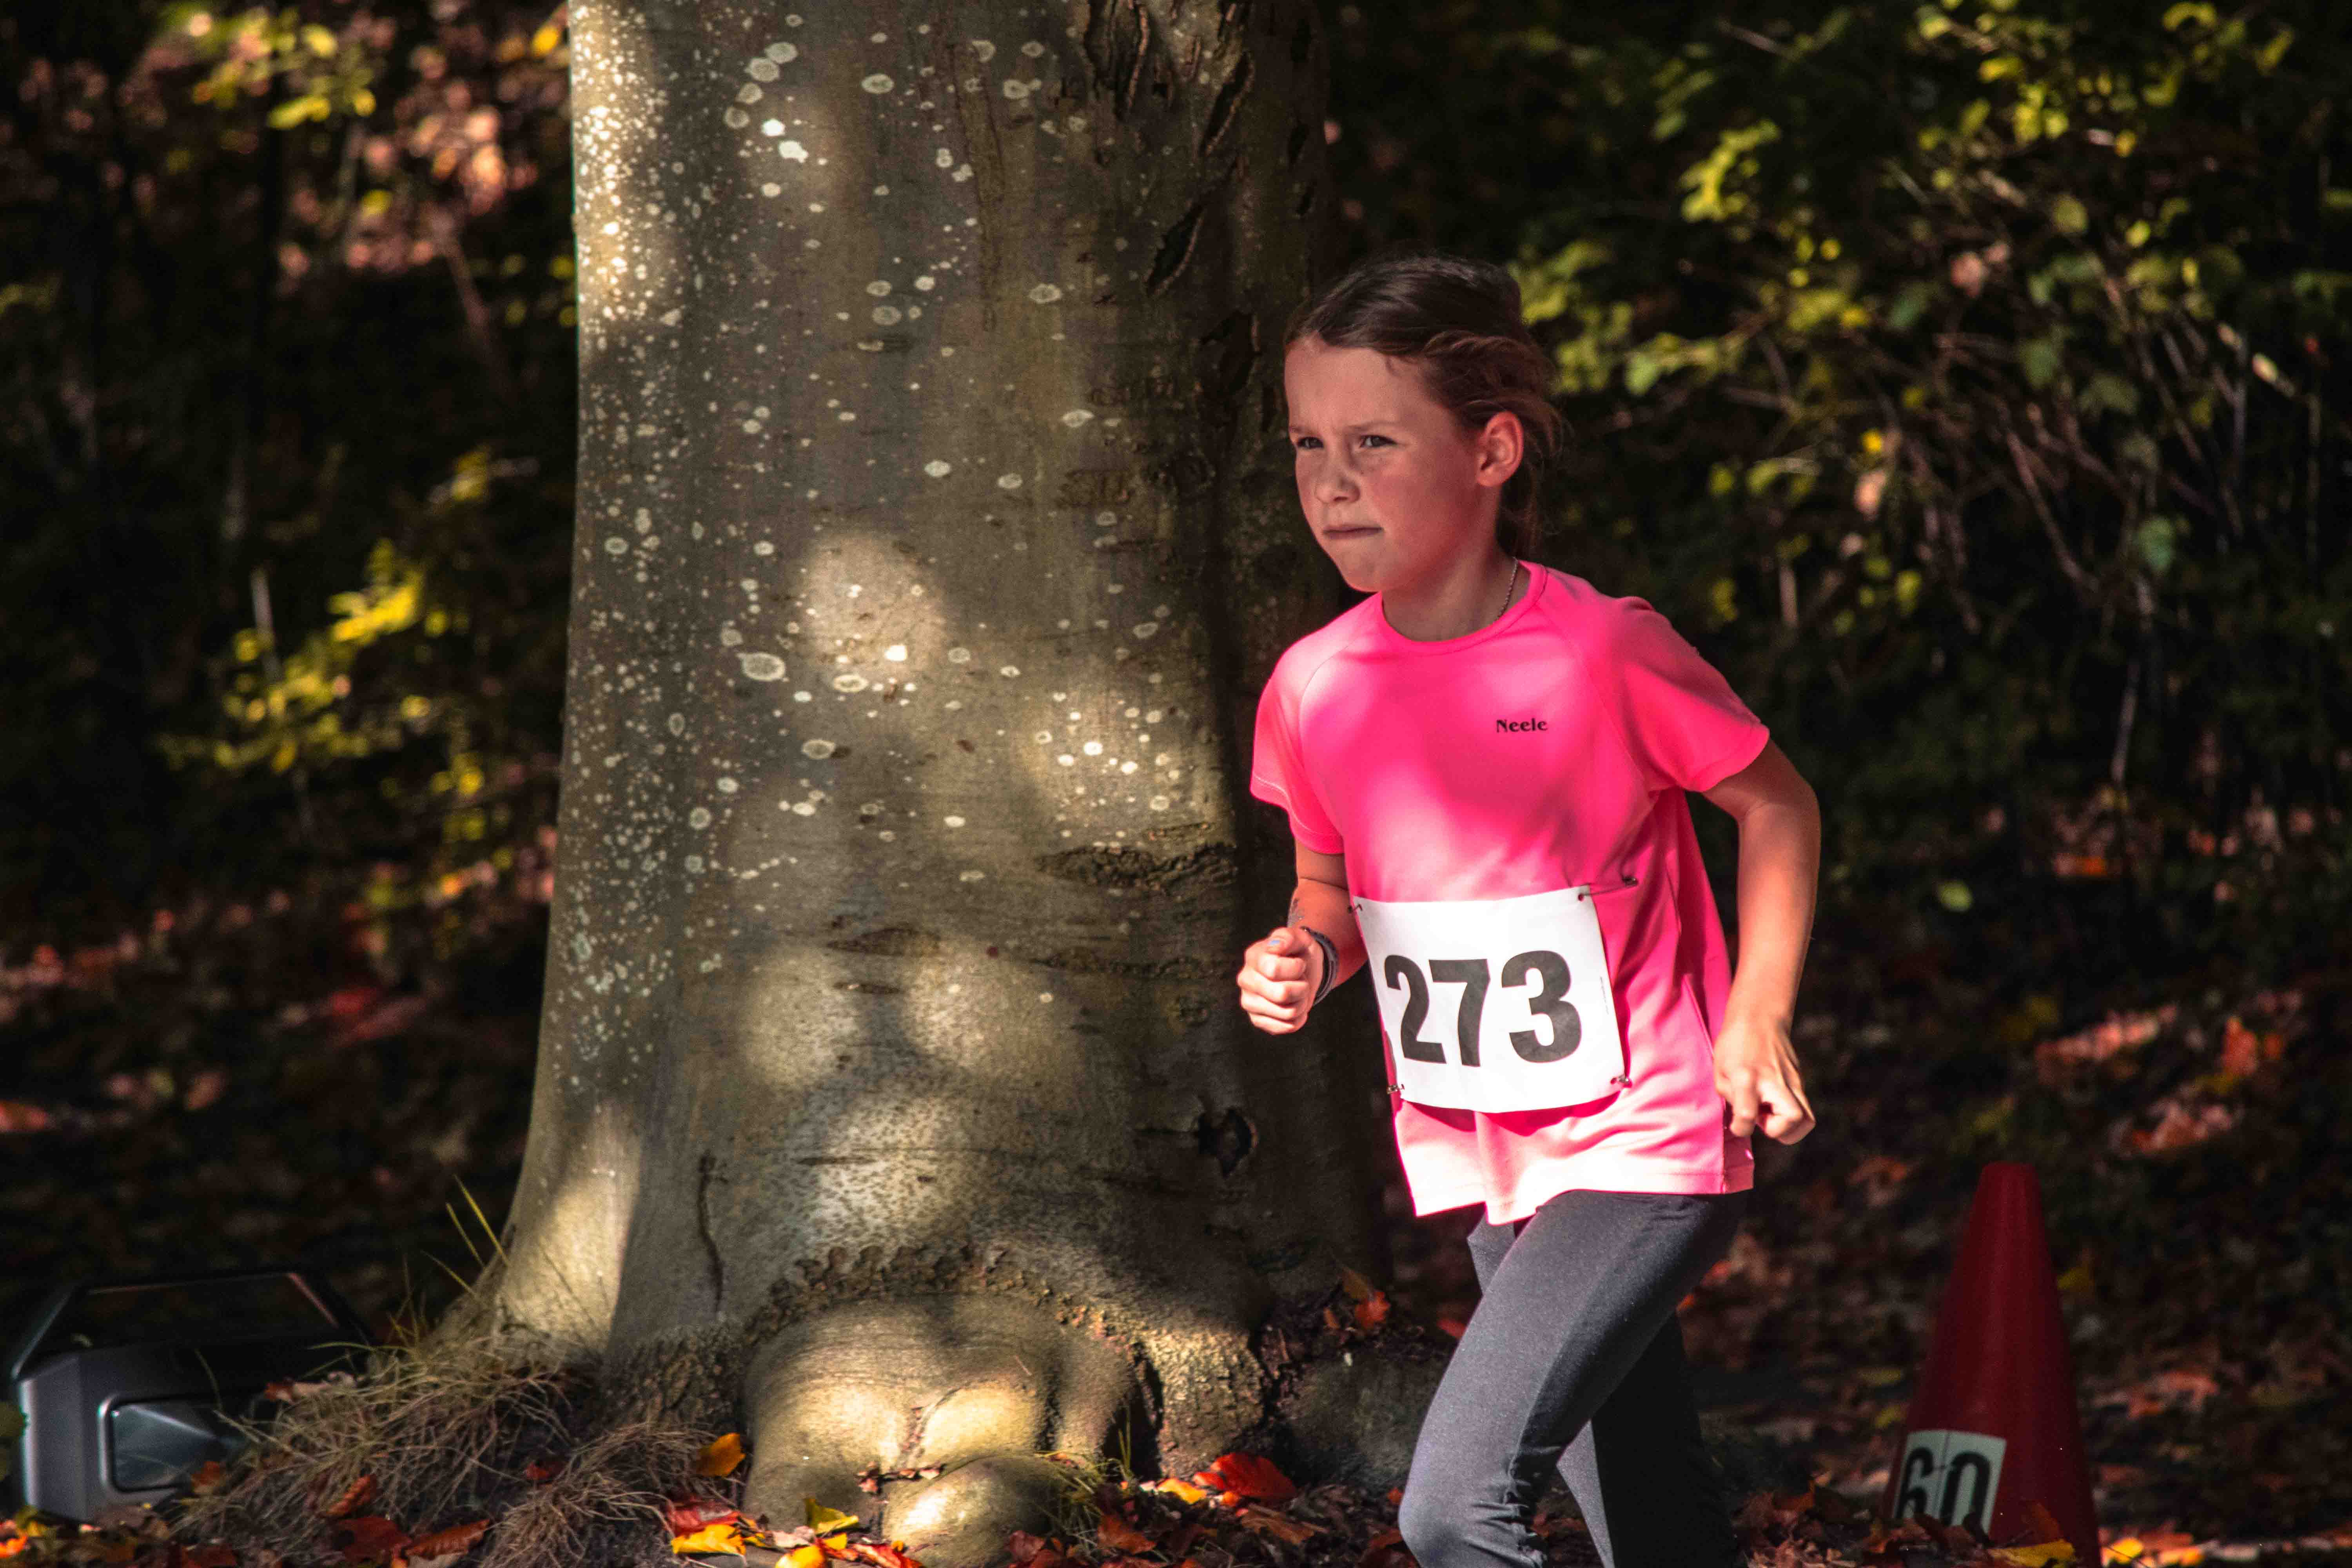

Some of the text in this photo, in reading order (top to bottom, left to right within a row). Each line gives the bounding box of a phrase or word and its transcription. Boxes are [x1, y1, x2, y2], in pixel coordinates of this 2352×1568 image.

[1496, 718, 1547, 733] Neele
[1384, 951, 1582, 1067] 273
[1895, 1447, 1990, 1527] 60
